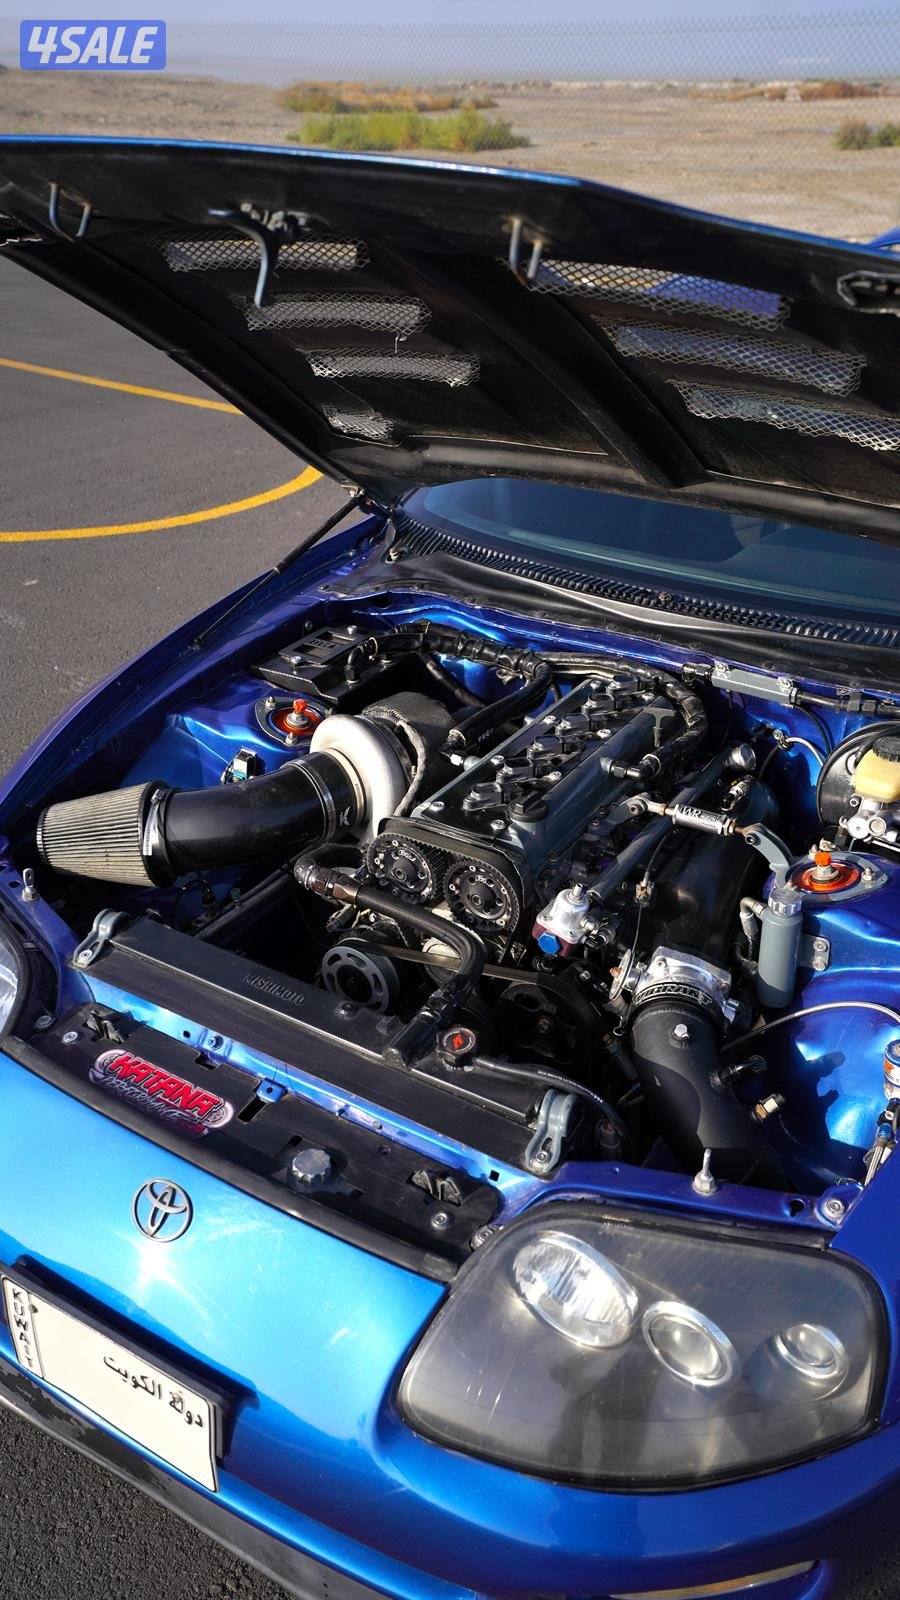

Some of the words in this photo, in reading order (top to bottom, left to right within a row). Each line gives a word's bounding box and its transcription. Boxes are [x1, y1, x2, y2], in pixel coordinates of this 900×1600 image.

[241, 973, 305, 1006] MISHIMOTO
[110, 1053, 223, 1119] KATANA
[12, 1288, 33, 1368] KUWAIT
[103, 1355, 162, 1400] الكويت
